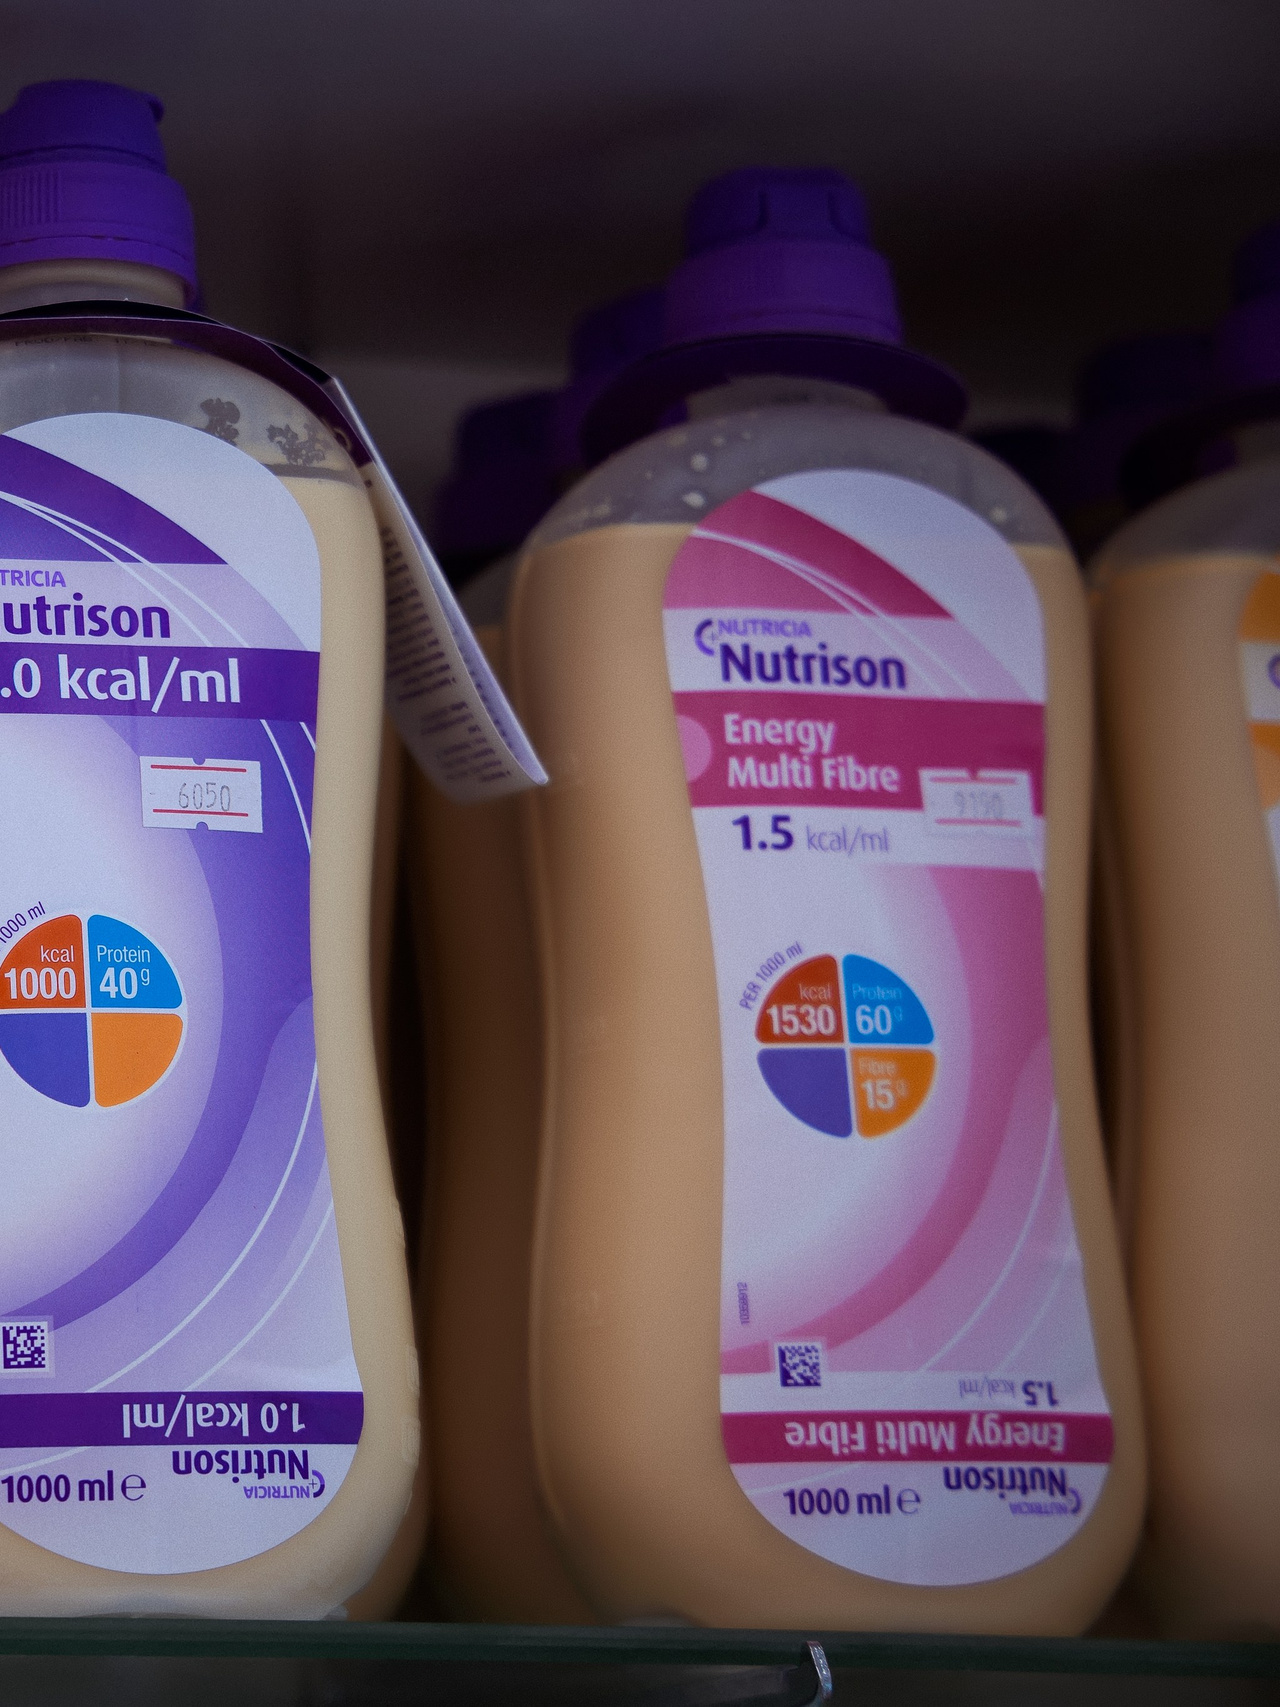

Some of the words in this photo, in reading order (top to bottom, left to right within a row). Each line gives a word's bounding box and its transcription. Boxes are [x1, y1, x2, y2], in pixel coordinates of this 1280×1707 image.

[718, 617, 812, 639] NUTRICIA
[720, 642, 907, 690] Nutrison
[58, 654, 241, 713] kcal/ml
[723, 712, 835, 754] Energy
[727, 753, 813, 789] Multi
[821, 756, 901, 793] Fibre
[178, 781, 231, 812] 6050
[732, 815, 793, 851] 1.5
[806, 822, 890, 858] kcal/ml
[27, 900, 47, 922] ml
[40, 945, 75, 963] kcal
[96, 945, 151, 963] Protein
[4, 967, 76, 1000] 1000
[738, 980, 761, 1011] PER
[756, 951, 786, 981] 1000
[785, 941, 804, 957] ml
[799, 983, 831, 1000] kcal
[852, 983, 902, 1000] Protein
[766, 1004, 835, 1036] 1530
[958, 1376, 1015, 1399] kcal/ml
[1022, 1379, 1059, 1407] 1.5
[122, 1394, 249, 1438] kcal/ml
[261, 1401, 306, 1433] 1.0
[785, 1421, 866, 1455] Fibre
[876, 1421, 956, 1456] Multi
[966, 1413, 1066, 1453] Energy
[172, 1449, 309, 1484] Nutrison
[943, 1466, 1067, 1499] Nutrison
[1, 1474, 72, 1503] 1000
[77, 1469, 114, 1502] ml
[243, 1485, 311, 1499] NUTRICIA
[783, 1488, 851, 1516] 1000
[857, 1484, 891, 1514] ml
